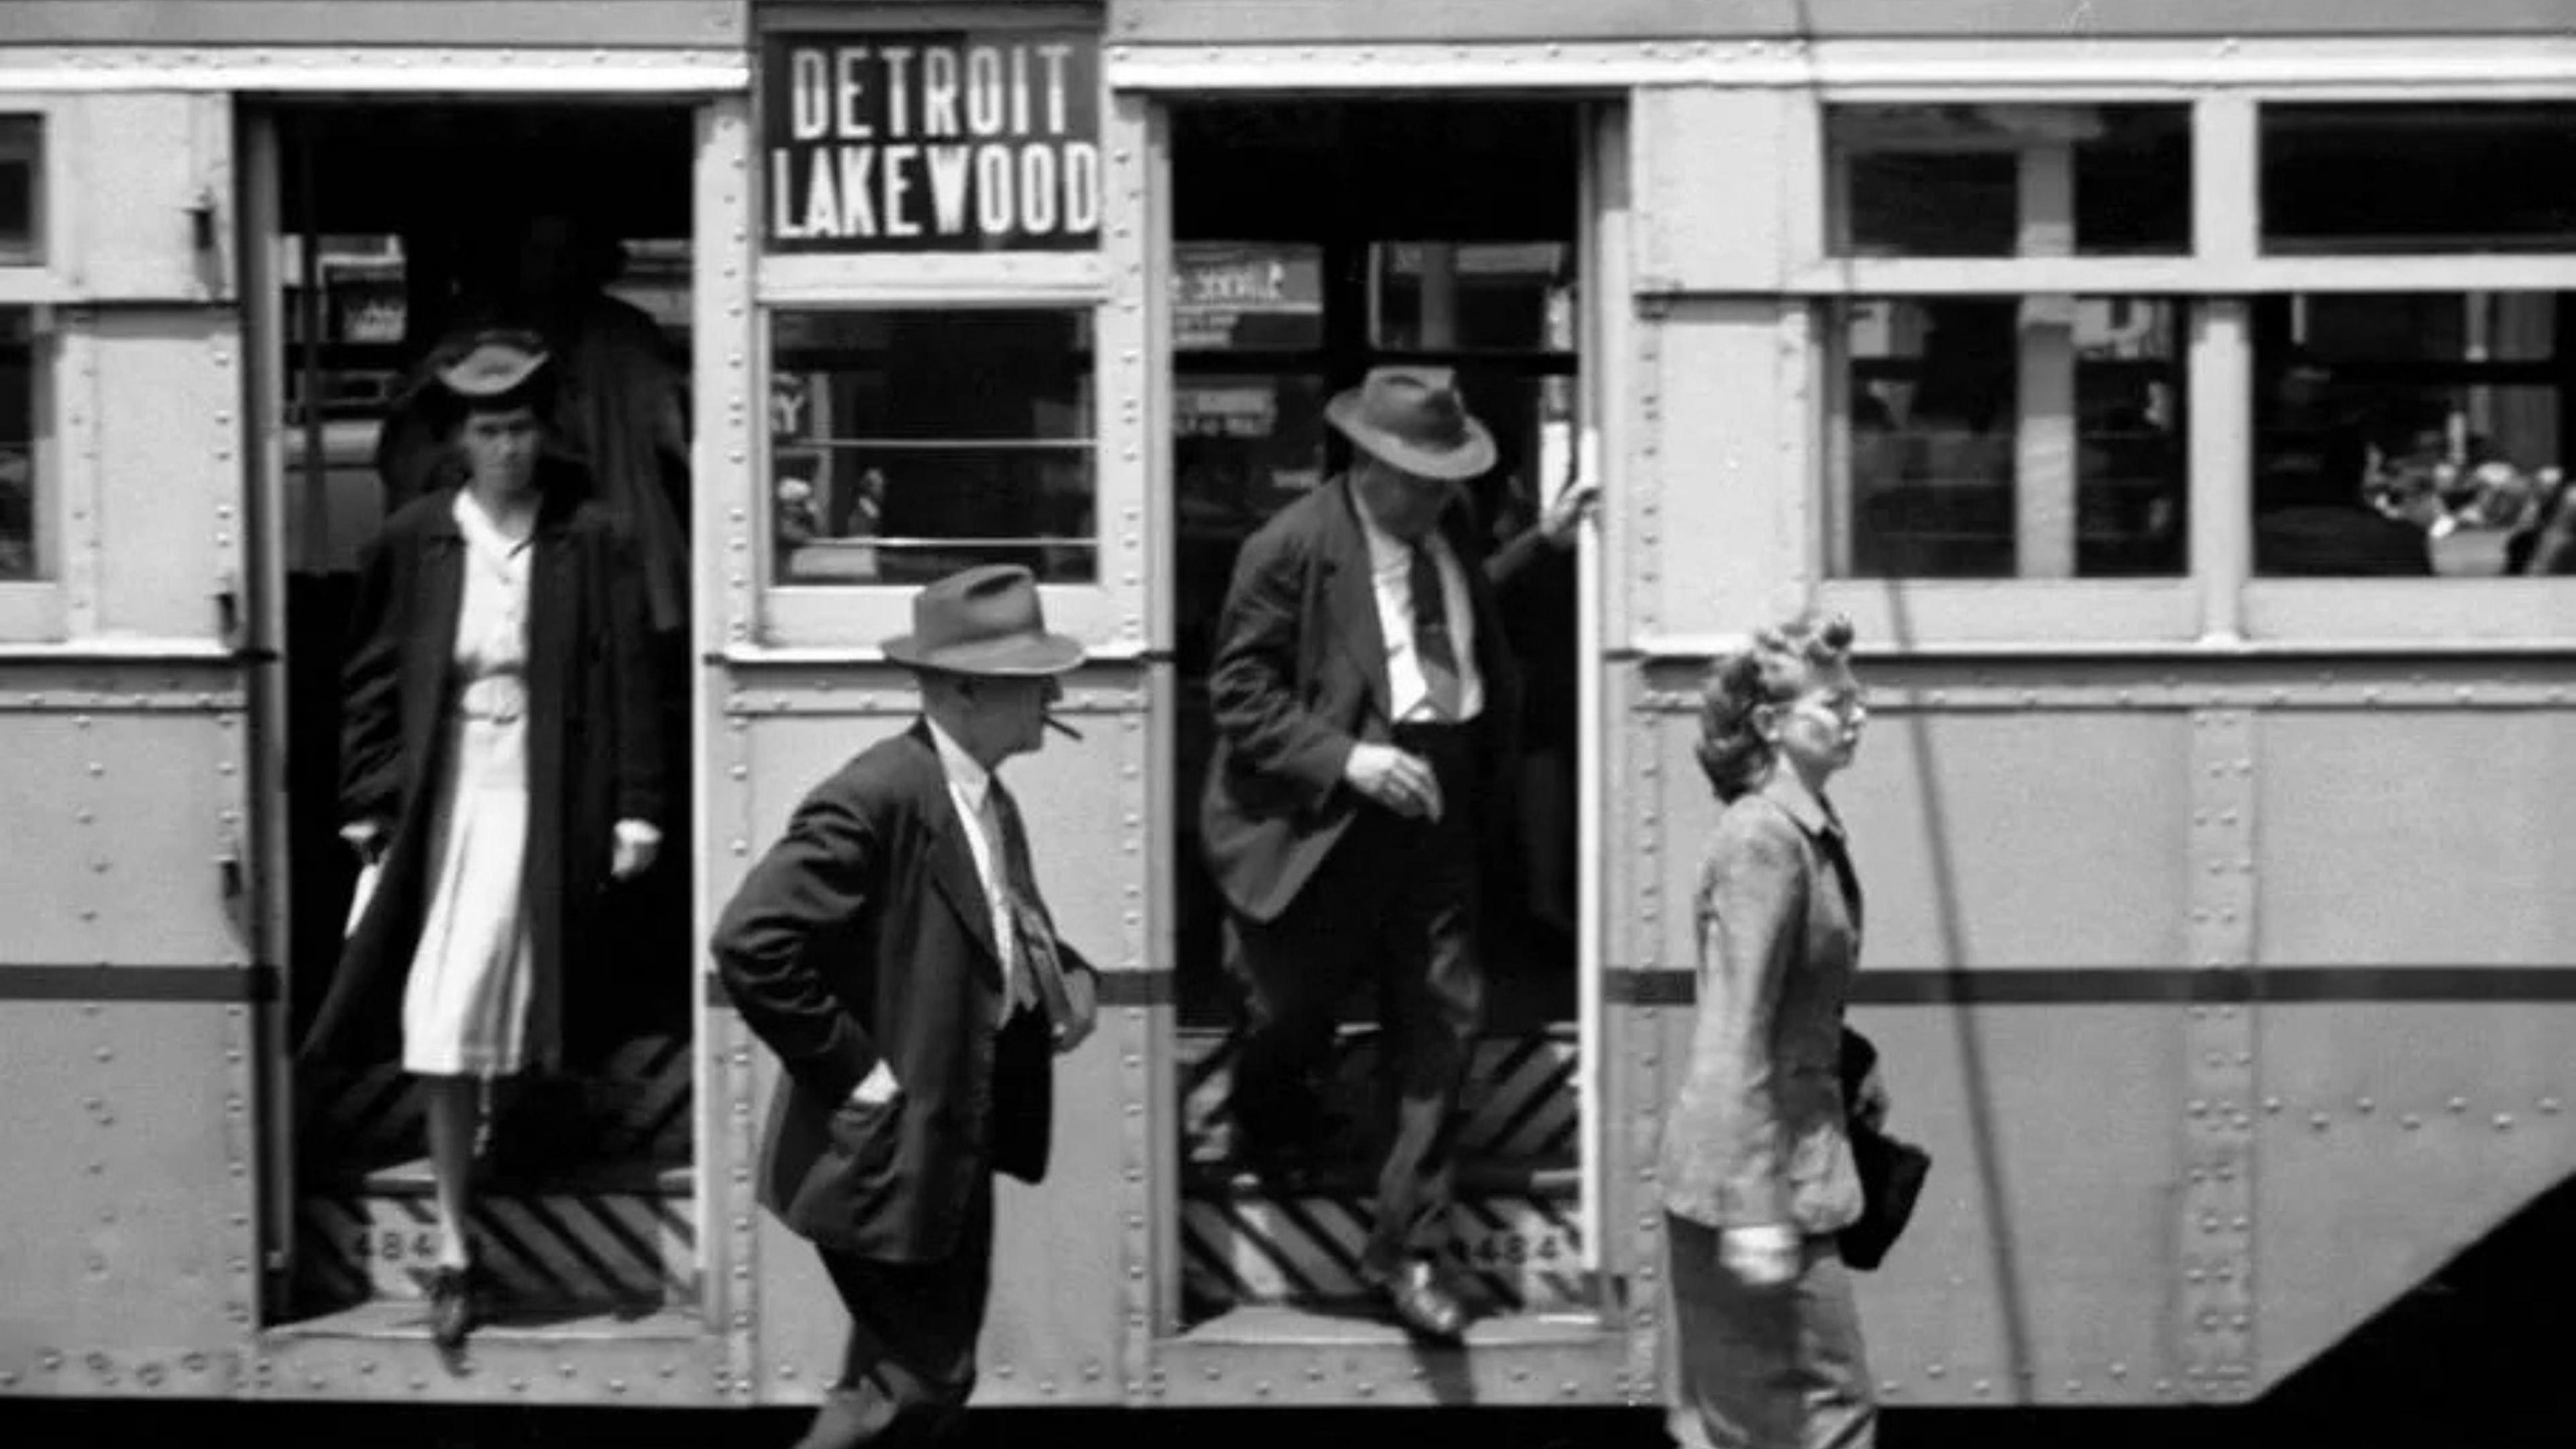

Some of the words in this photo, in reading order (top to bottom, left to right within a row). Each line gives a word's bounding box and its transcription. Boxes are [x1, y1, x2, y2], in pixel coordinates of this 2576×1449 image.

[793, 46, 1071, 139] DETROIT
[773, 142, 1099, 238] LAKEWOOD
[354, 1232, 433, 1260] 484
[1474, 1235, 1559, 1264] 484
